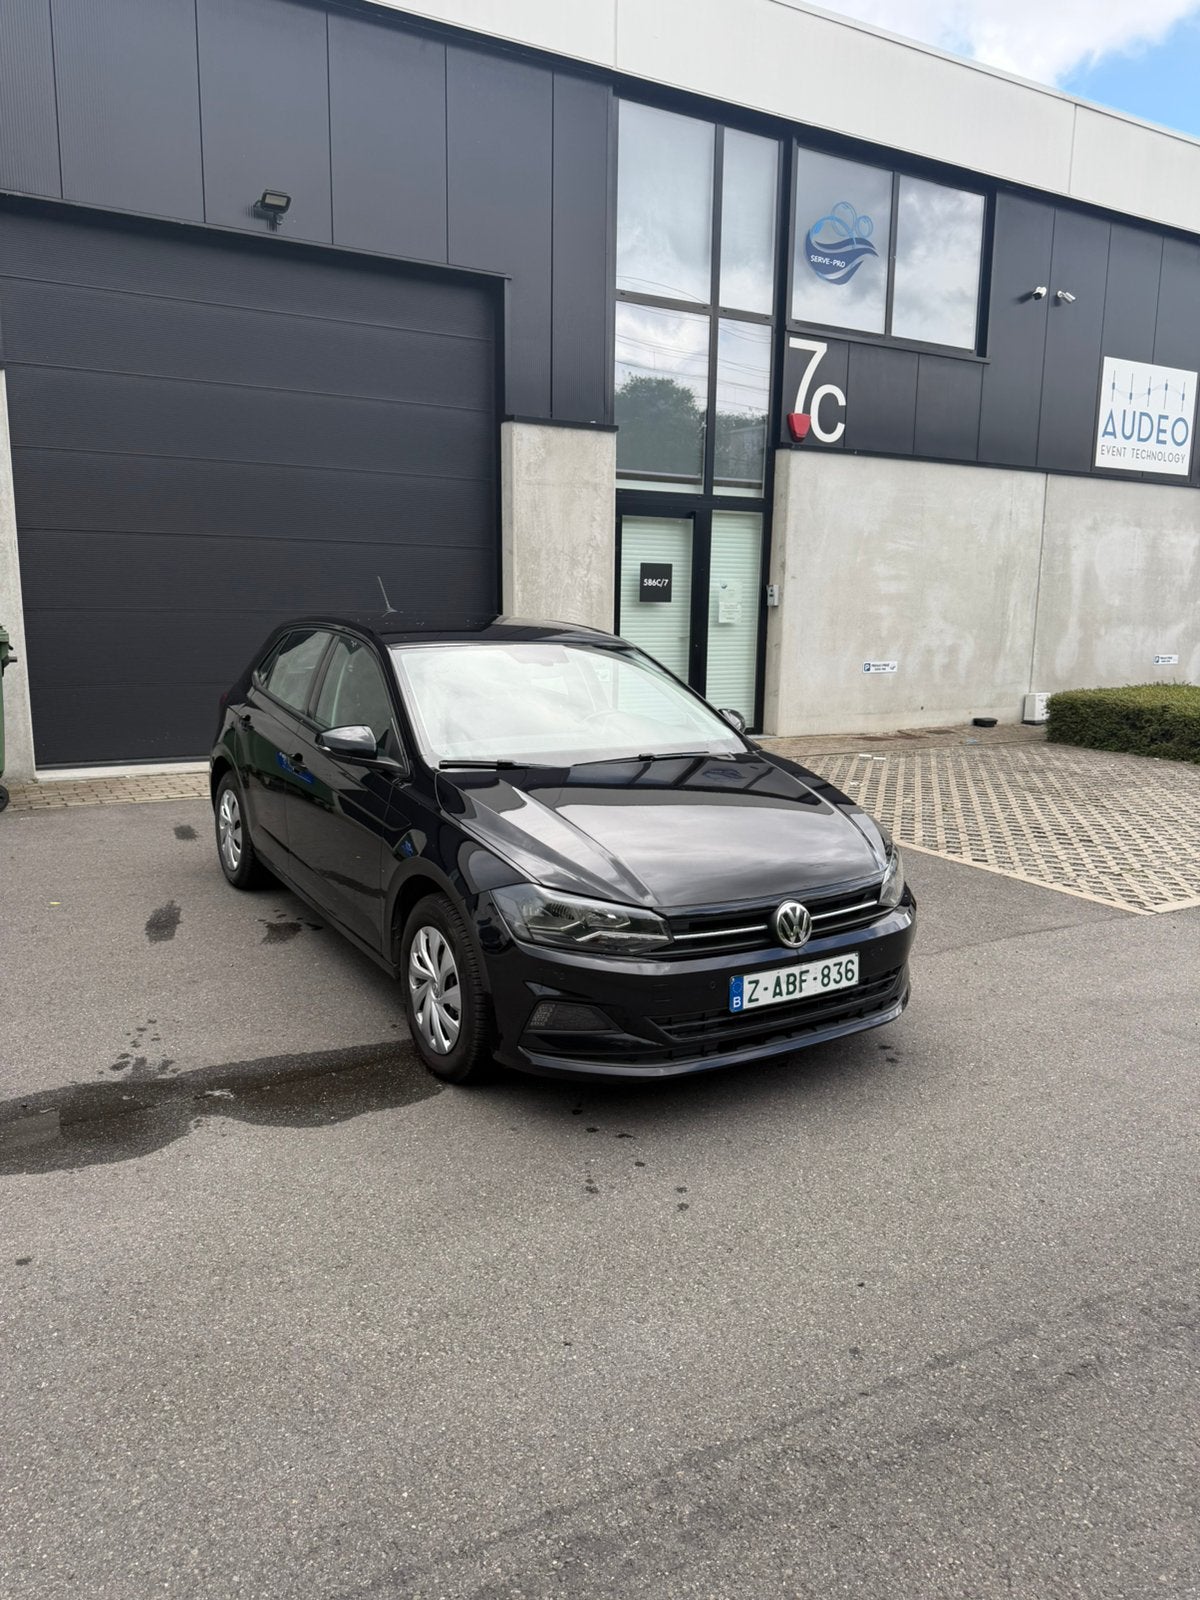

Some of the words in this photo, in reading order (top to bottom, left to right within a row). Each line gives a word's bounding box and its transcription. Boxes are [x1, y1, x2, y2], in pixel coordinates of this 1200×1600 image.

[810, 254, 846, 268] SERVE-PRO
[1102, 408, 1189, 447] AUDEO
[1100, 444, 1127, 458] EVENT
[1131, 447, 1186, 464] TECHNOLOGY
[643, 578, 669, 588] 586C/7
[733, 996, 742, 1008] B
[747, 959, 855, 1004] Z-ABF-836
